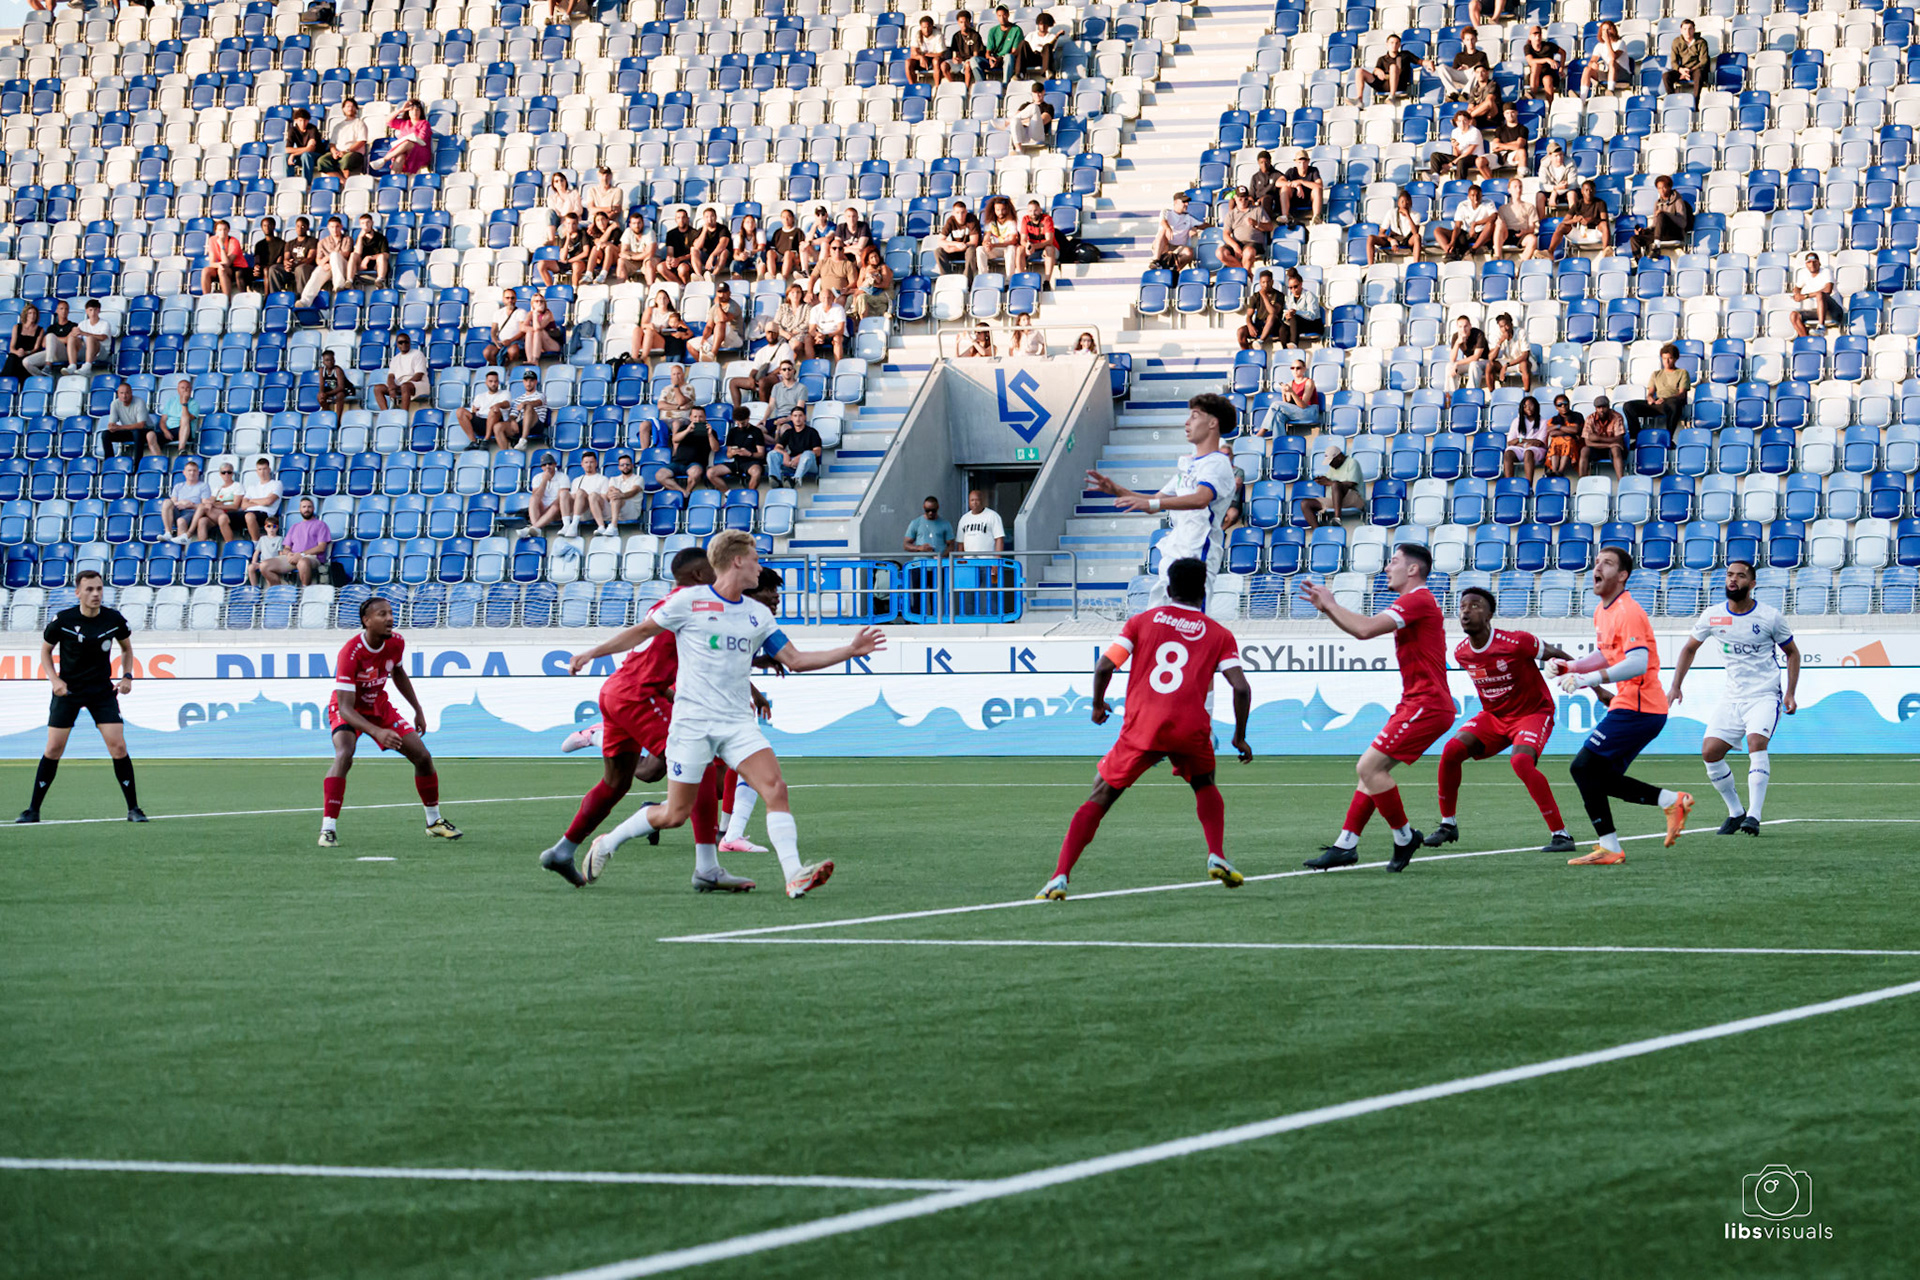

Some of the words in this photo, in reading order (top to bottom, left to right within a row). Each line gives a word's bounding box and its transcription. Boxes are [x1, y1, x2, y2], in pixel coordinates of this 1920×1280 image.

[994, 368, 1052, 445] LS
[1087, 566, 1095, 577] 3
[1733, 643, 1761, 655] BCV
[1149, 641, 1189, 694] 8
